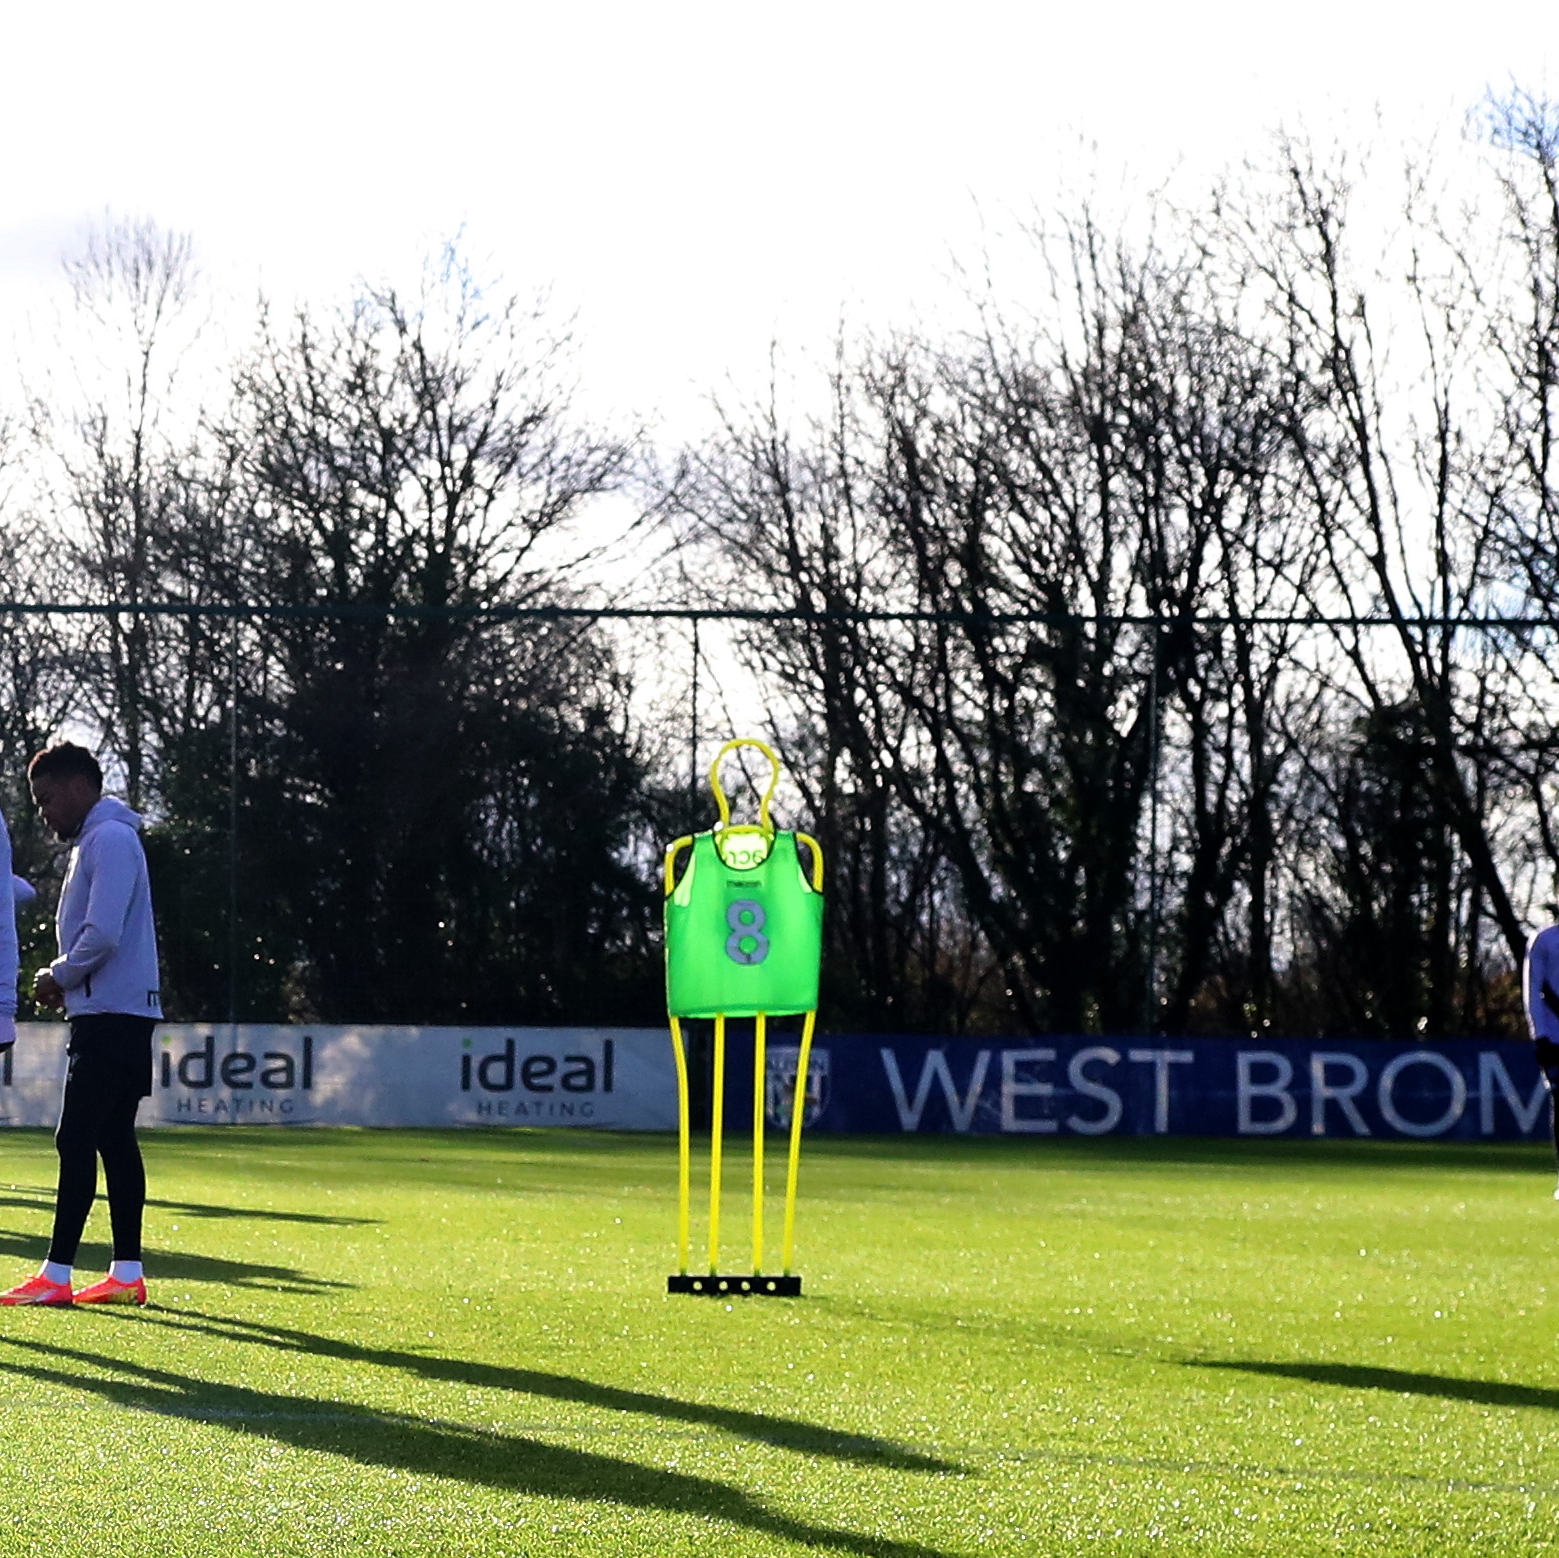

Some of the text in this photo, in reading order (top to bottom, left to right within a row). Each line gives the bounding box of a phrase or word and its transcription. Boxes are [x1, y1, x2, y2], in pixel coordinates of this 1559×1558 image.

[725, 899, 770, 966] 8
[161, 1036, 313, 1091] ideal
[461, 1039, 614, 1094] ideal
[176, 1098, 295, 1115] HEATING
[476, 1100, 595, 1118] HEATING
[880, 1047, 1194, 1136] WEST
